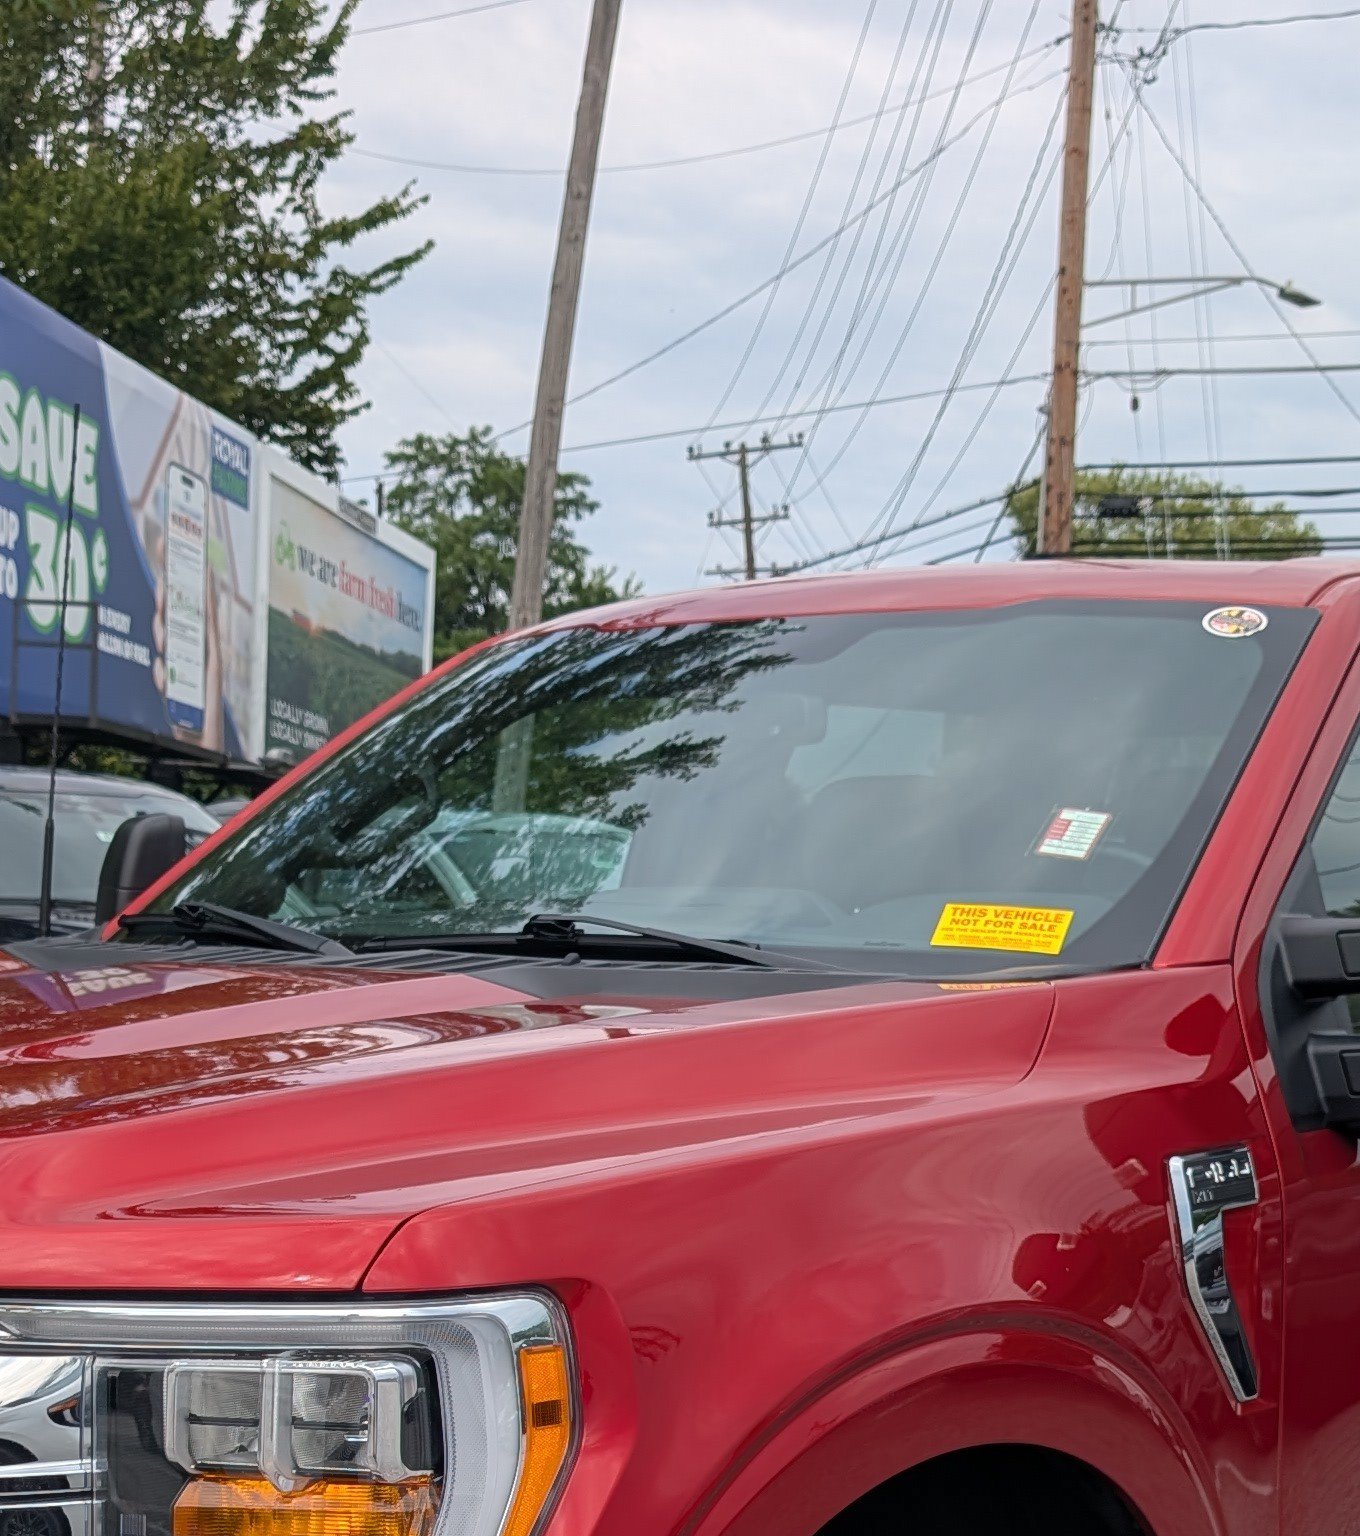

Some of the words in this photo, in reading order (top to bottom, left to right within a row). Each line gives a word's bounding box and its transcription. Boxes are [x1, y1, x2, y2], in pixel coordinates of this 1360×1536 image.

[951, 907, 988, 918] THIS
[993, 909, 1066, 924] VEHICLE
[949, 918, 981, 927] NOT
[983, 920, 1015, 929] FOR
[1018, 922, 1057, 933] SALE
